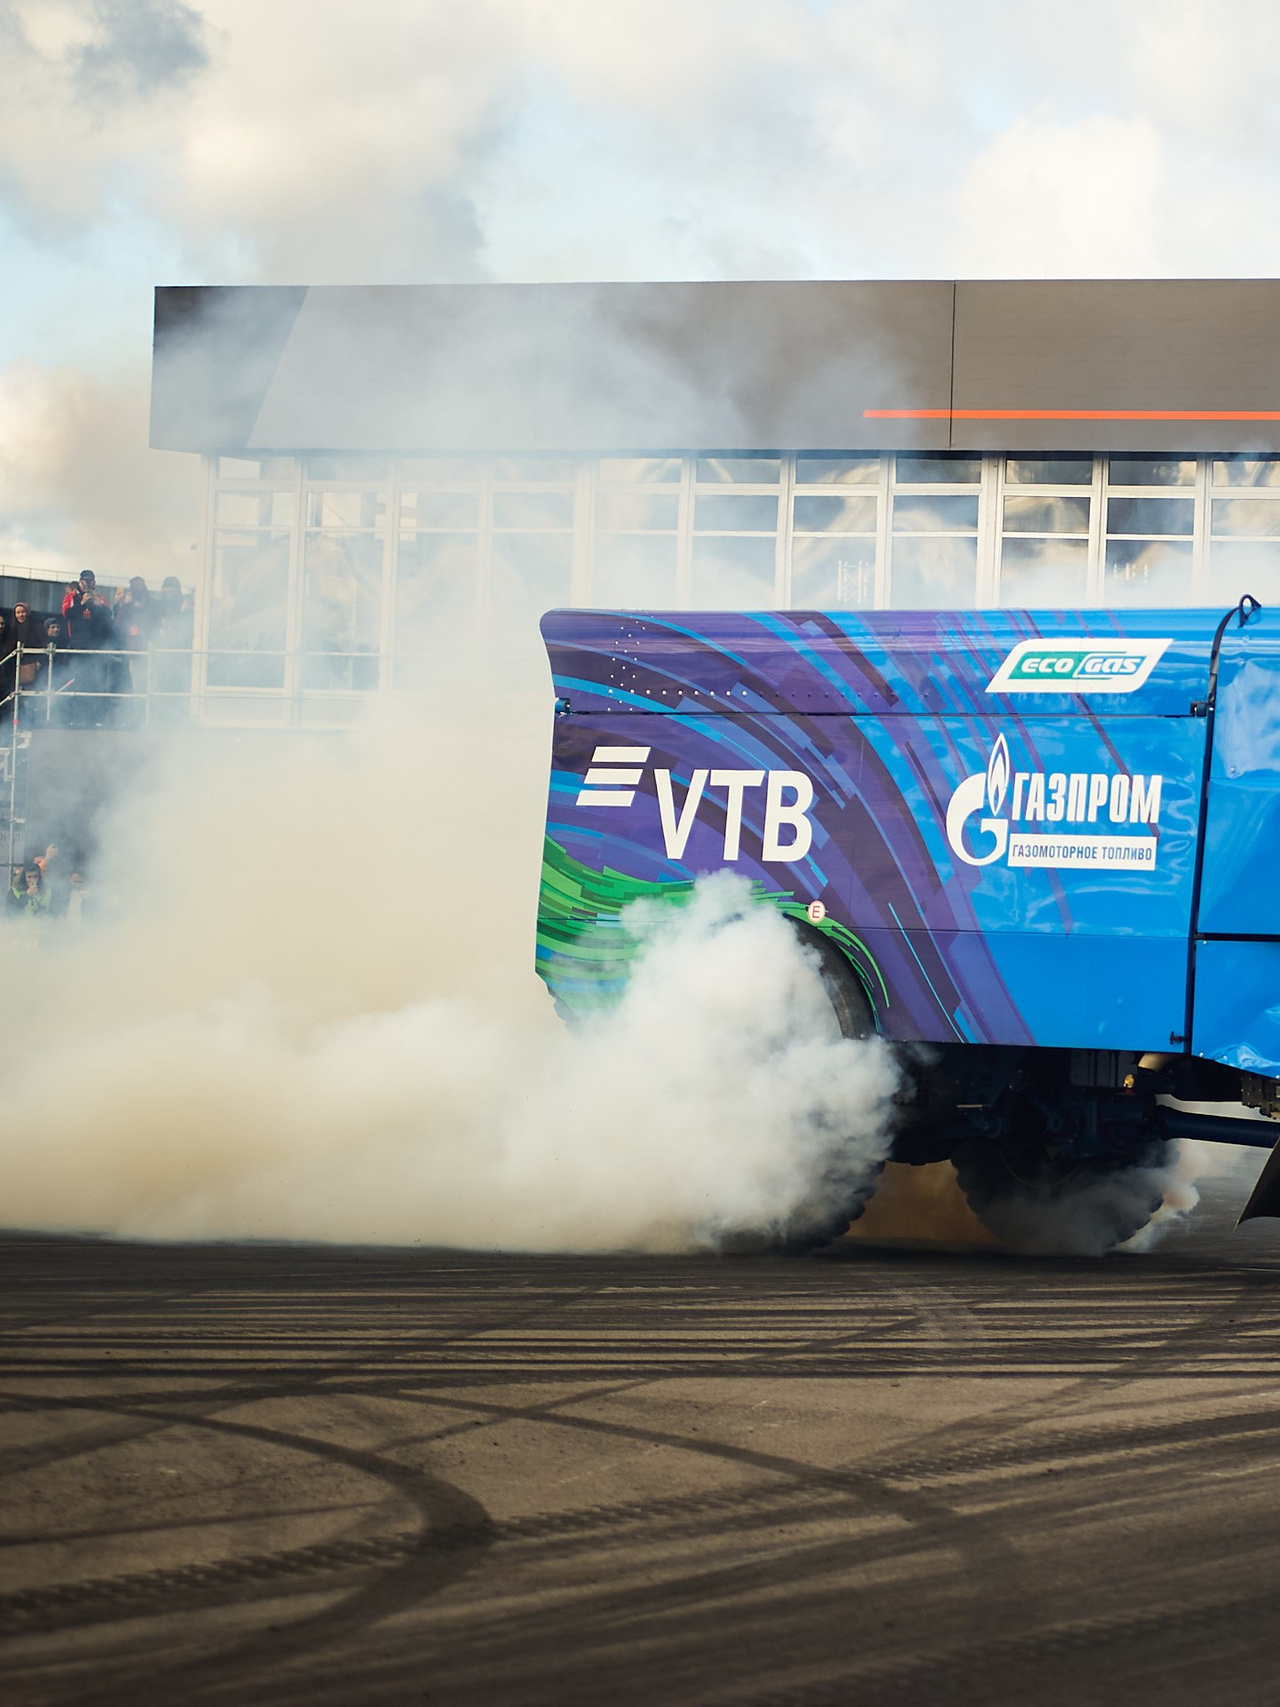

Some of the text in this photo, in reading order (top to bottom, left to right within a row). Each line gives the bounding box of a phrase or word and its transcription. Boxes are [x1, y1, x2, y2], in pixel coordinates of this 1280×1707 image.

[653, 768, 814, 862] VTB
[1012, 772, 1163, 824] ГАЗПРОМ
[1012, 844, 1152, 861] ГАЗОМОТОРНОЕ ТОПЛИВО
